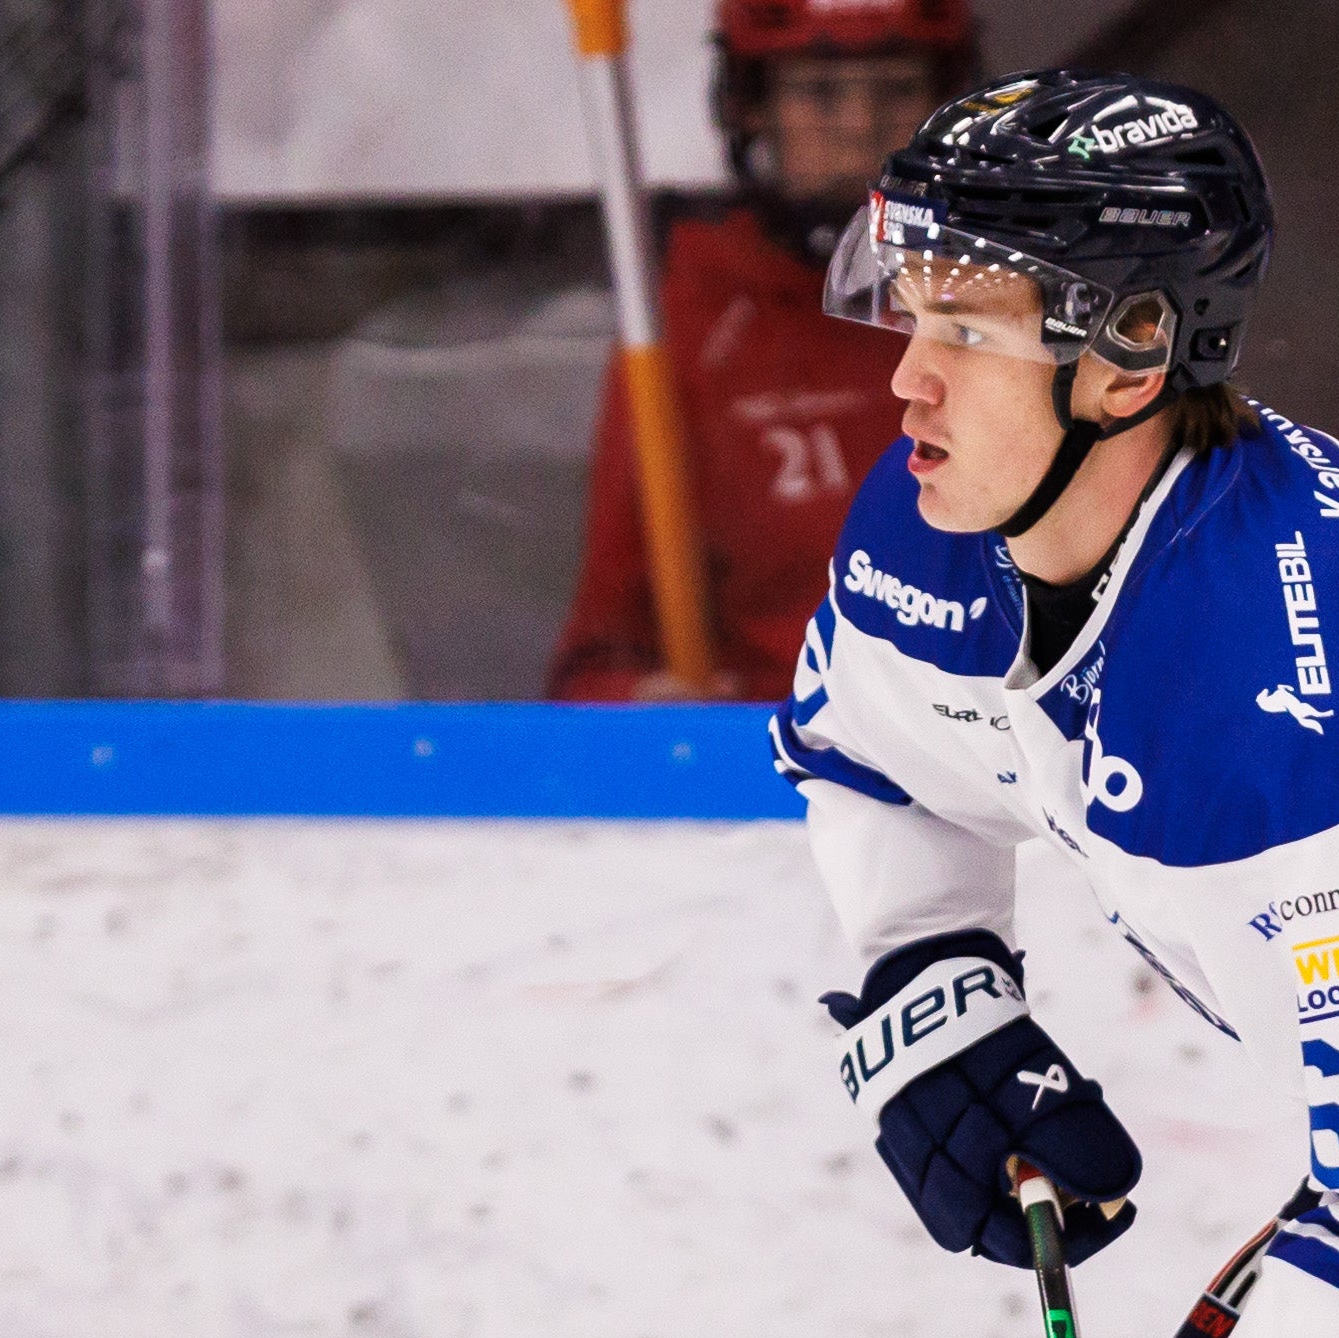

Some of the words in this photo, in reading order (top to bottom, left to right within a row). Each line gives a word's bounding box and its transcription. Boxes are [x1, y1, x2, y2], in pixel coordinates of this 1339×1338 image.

[1091, 103, 1199, 154] bravida
[1099, 206, 1192, 227] BAUER
[844, 549, 965, 633] Swegon
[1274, 529, 1333, 696] ELITEBIL
